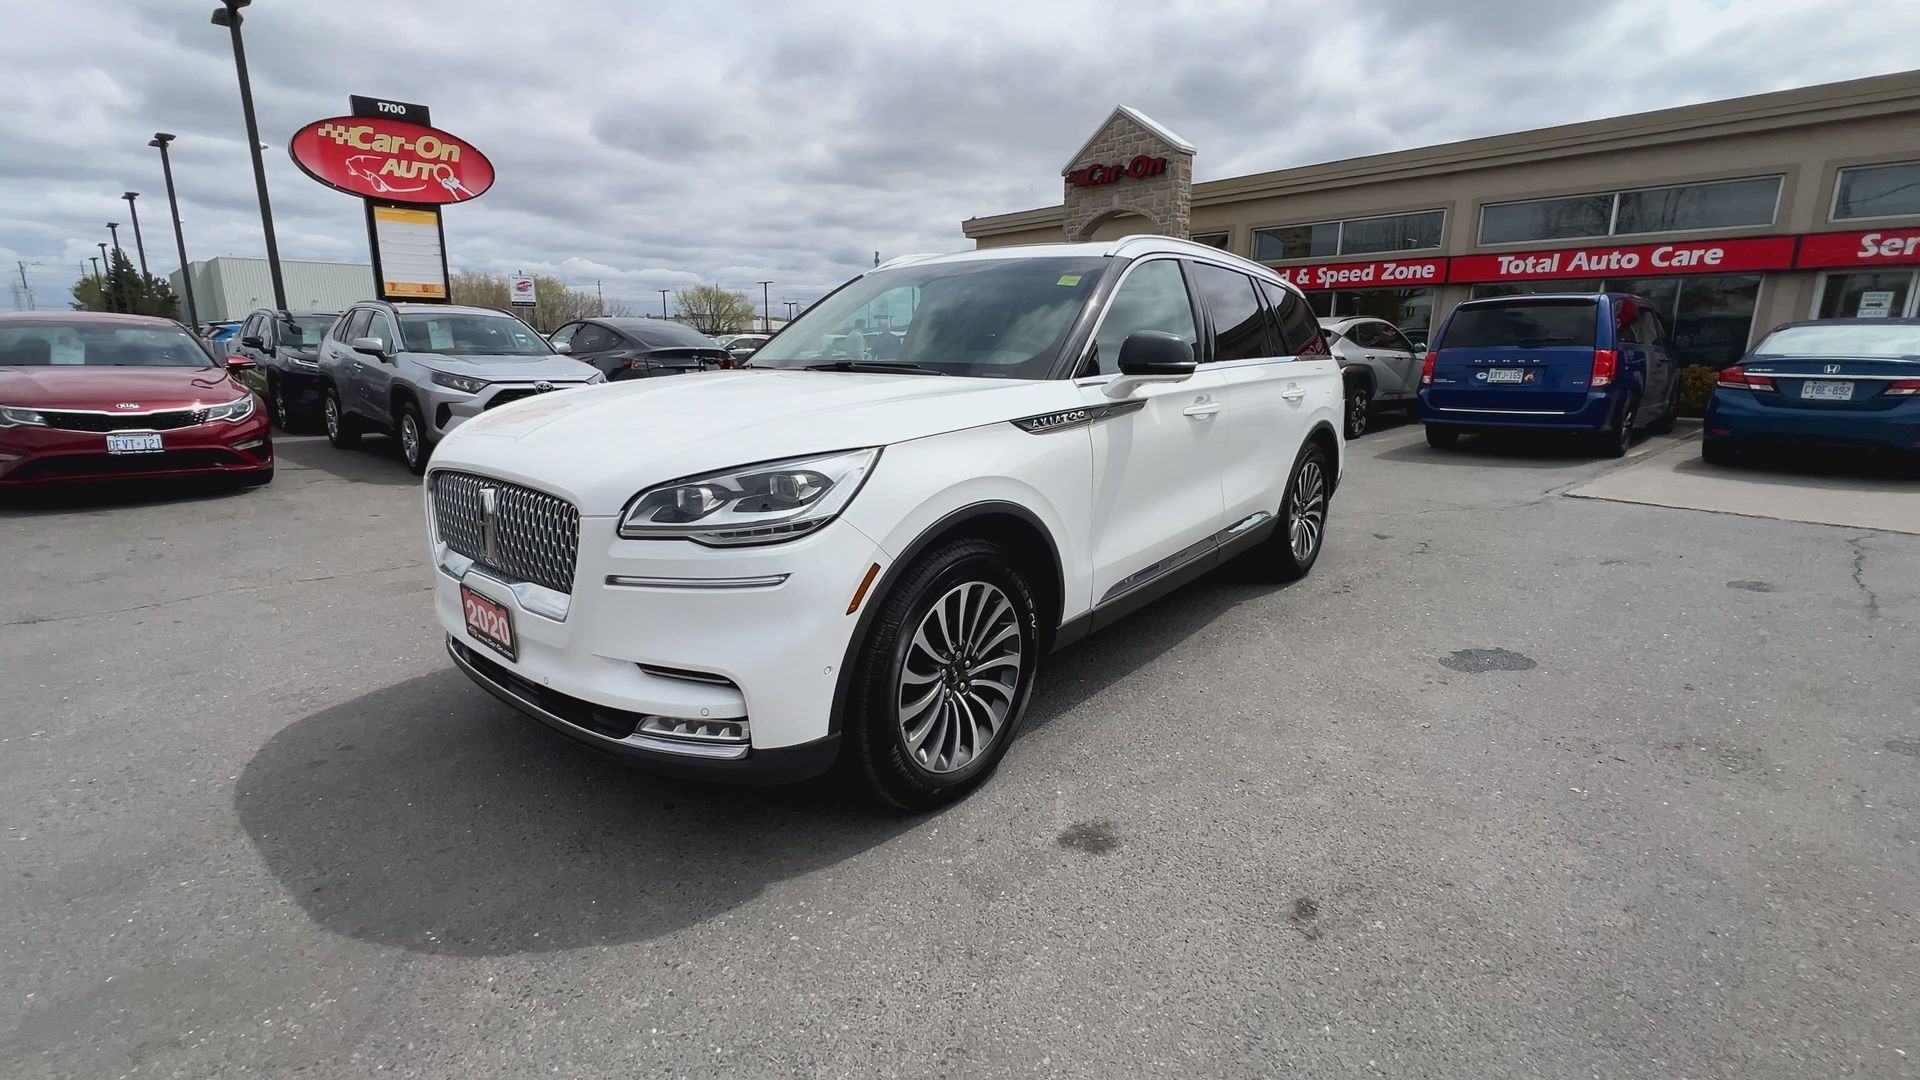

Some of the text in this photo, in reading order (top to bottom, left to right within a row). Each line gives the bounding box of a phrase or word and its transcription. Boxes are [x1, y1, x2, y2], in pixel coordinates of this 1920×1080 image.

[377, 102, 406, 115] 1700
[350, 125, 461, 163] Car-On
[379, 159, 455, 183] AUTO
[1498, 246, 1724, 275] Total Auto Care
[1296, 268, 1310, 285] &
[1316, 264, 1375, 289] Speed
[1381, 263, 1436, 280] Zone
[1031, 410, 1086, 429] AVIATOR
[466, 599, 511, 646] 2020
